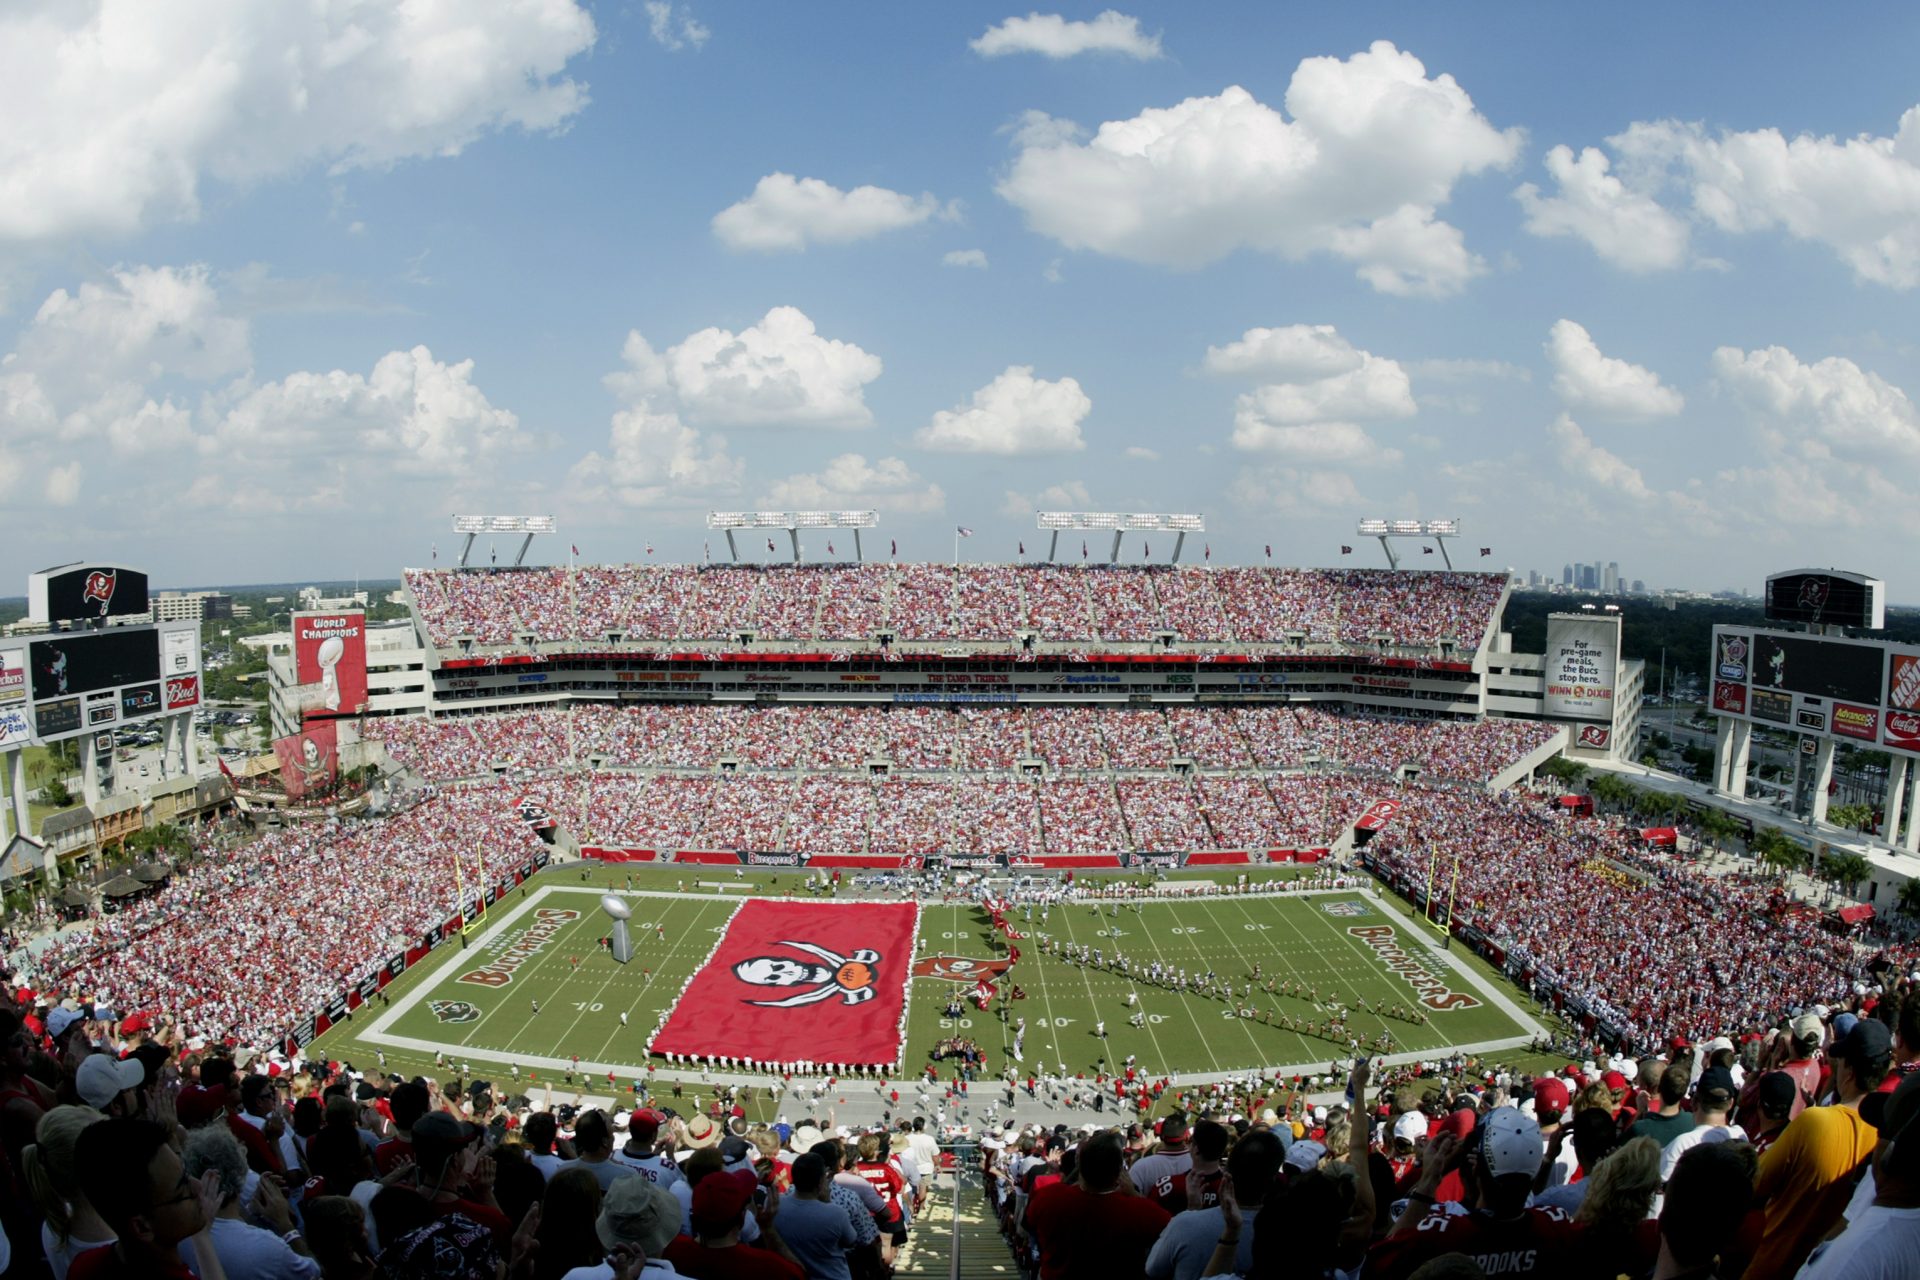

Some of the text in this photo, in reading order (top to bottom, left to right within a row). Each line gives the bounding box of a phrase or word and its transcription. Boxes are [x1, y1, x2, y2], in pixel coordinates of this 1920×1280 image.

[313, 618, 346, 629] WORLD
[302, 627, 358, 639] CHAMPIONS
[1575, 640, 1589, 649] For
[1561, 648, 1602, 657] pre-game
[1567, 657, 1594, 666] meals,
[1563, 665, 1598, 675] the Bucs
[1166, 675, 1193, 683] HESS
[1234, 674, 1287, 684] TECO
[1559, 674, 1600, 684] stop here.
[167, 681, 197, 703] Bud
[1547, 685, 1612, 699] WINN DIXIE
[576, 1002, 604, 1012] 10
[939, 1019, 973, 1029] 50
[1036, 1018, 1068, 1027] 40
